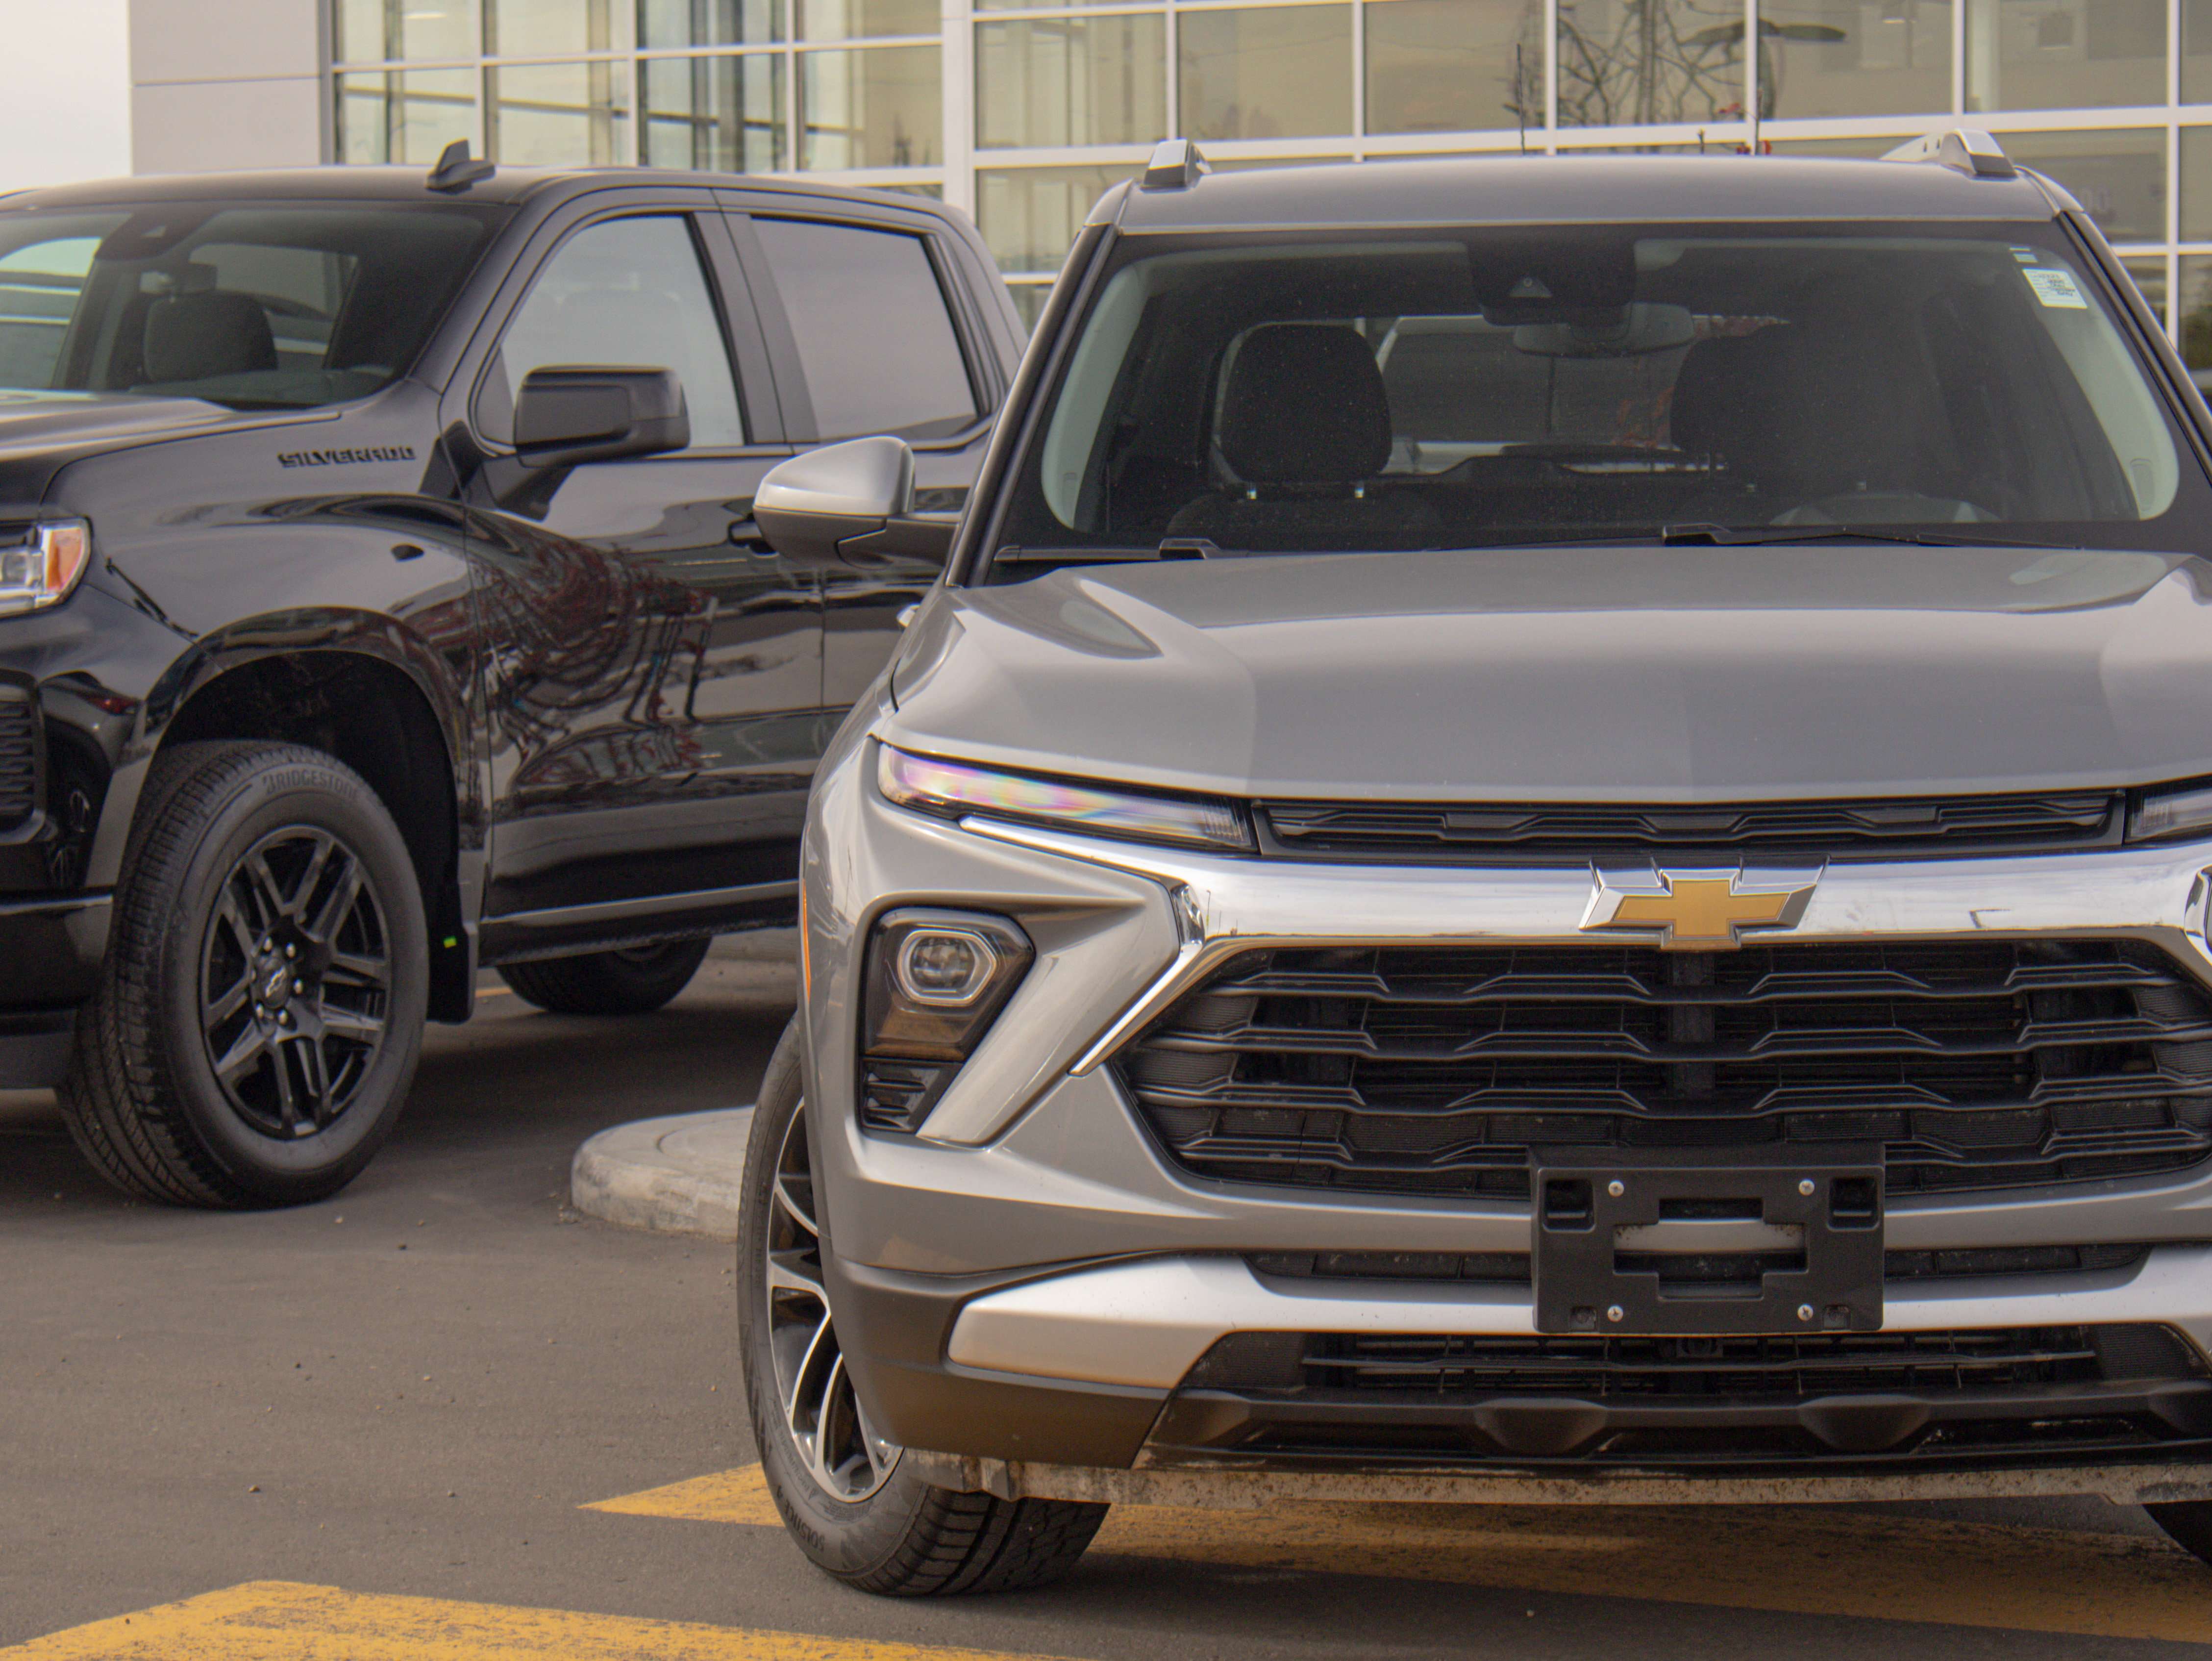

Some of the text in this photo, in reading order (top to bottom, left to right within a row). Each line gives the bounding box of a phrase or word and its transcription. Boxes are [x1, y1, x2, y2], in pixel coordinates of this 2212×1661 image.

[277, 446, 416, 467] SILVERADO
[262, 769, 358, 800] BRIDGESTONE
[784, 1498, 825, 1552] SOLSTICE
